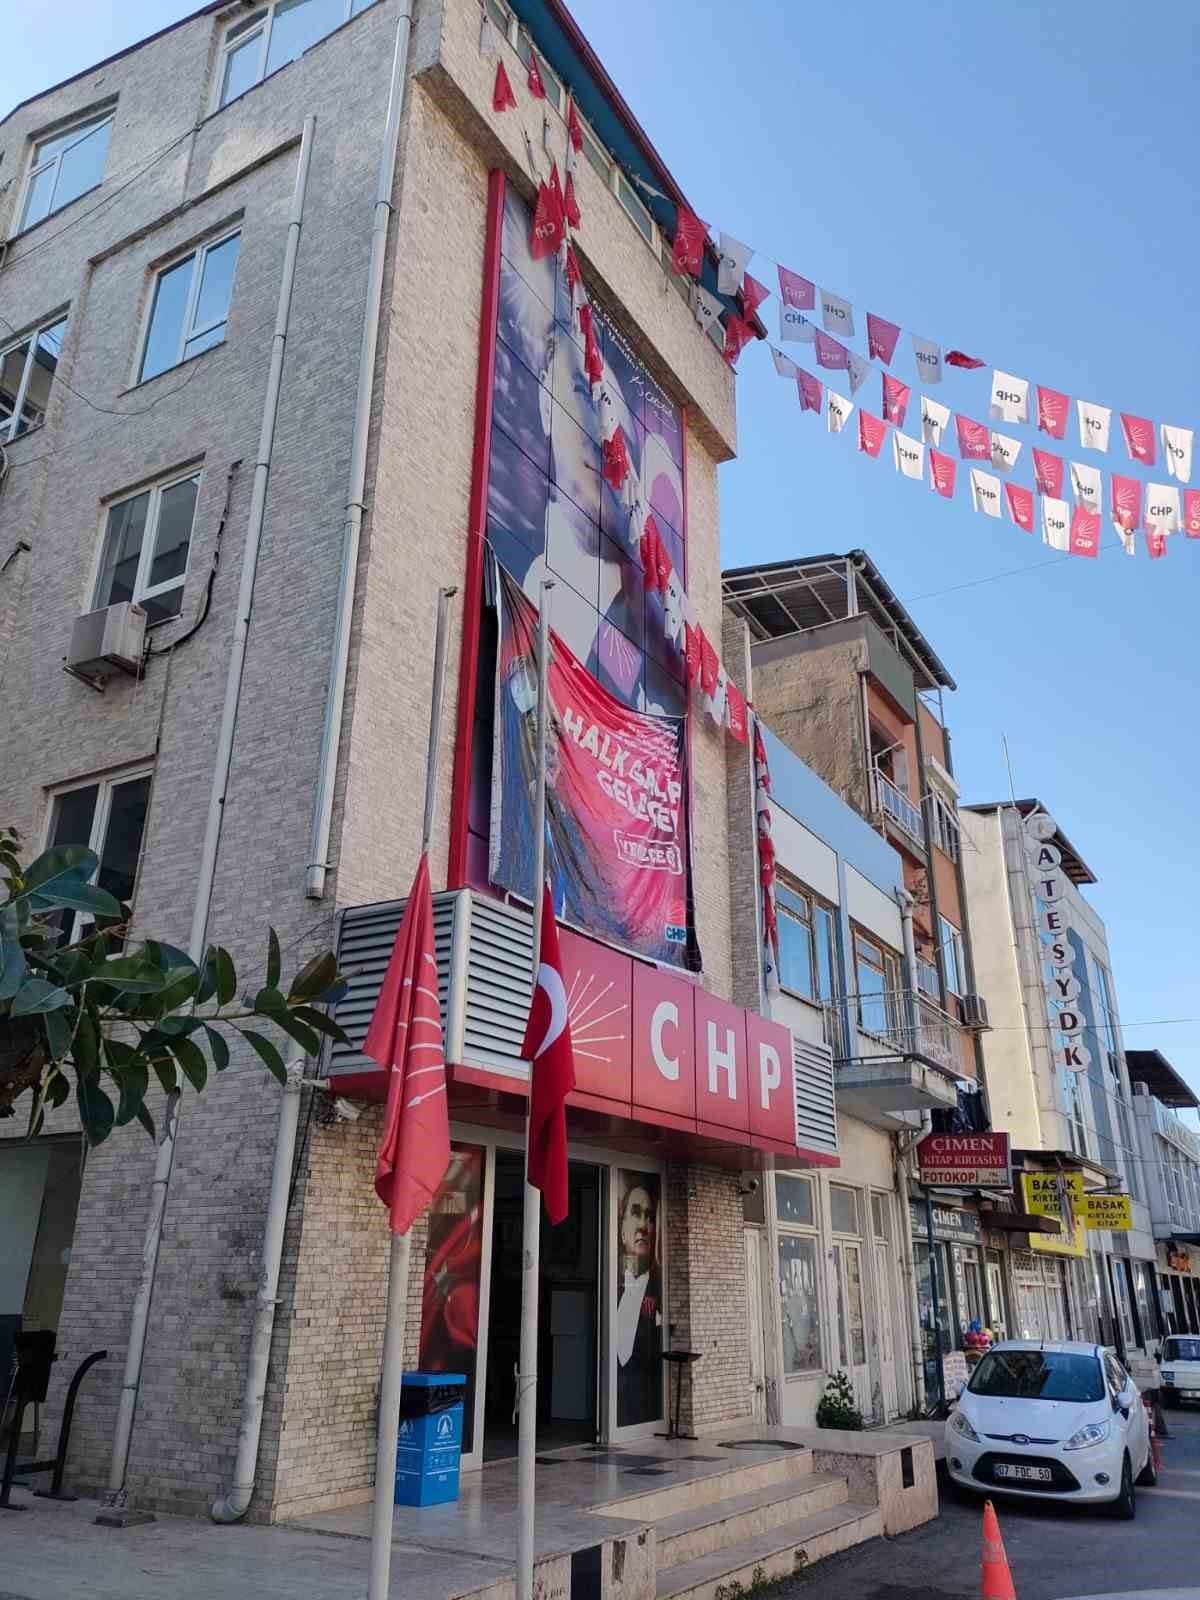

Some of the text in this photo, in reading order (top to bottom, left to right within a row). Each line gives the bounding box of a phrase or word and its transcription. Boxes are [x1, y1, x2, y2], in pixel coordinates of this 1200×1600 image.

[976, 486, 997, 500] CHP
[1150, 505, 1173, 516] CHP
[1047, 517, 1065, 530] CHP
[1075, 537, 1094, 549] CHP
[563, 706, 631, 778] HALK
[665, 926, 686, 941] CHP
[650, 1000, 782, 1111] CHP
